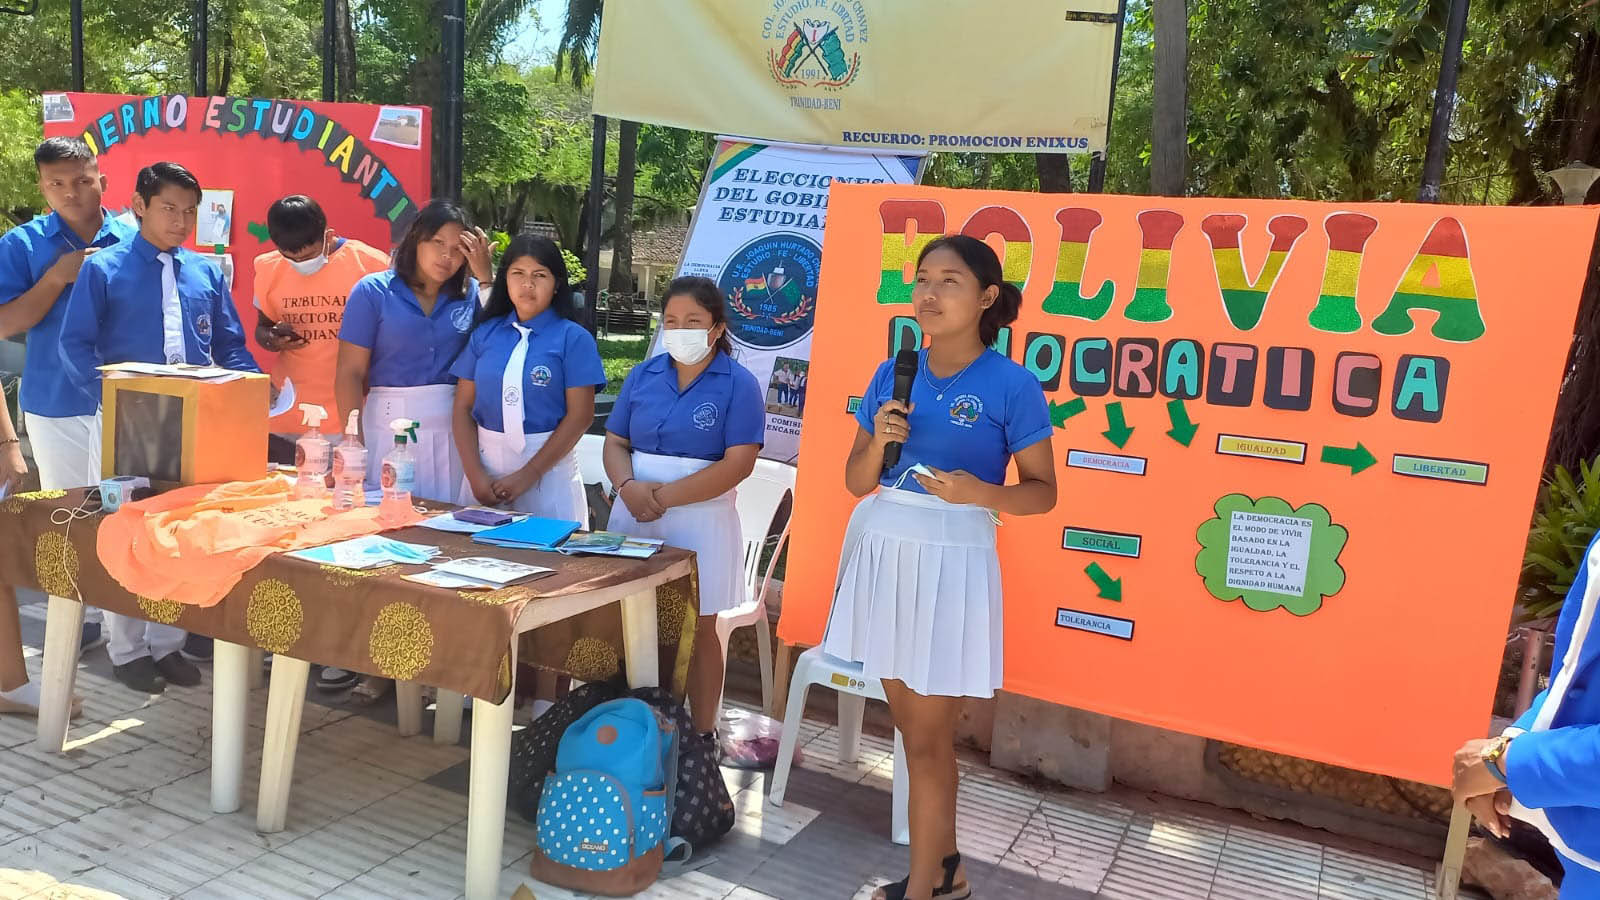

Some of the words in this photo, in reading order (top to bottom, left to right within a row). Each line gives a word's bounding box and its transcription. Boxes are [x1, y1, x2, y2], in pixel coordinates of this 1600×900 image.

[802, 69, 820, 79] 1991
[790, 96, 840, 110] TRINIDAD-BENI
[842, 132, 925, 145] RECUERDO:
[929, 134, 1022, 148] PROMOCION
[1026, 136, 1088, 148] ENIXUS
[712, 187, 758, 202] DEL
[746, 242, 778, 260] JOAQUIN
[741, 252, 770, 279] ESTUDIO
[876, 200, 1486, 342] BOLIVIA
[894, 317, 1439, 412] DOCRATICA
[1237, 442, 1288, 455] IGUALDAD
[1413, 464, 1467, 476] LIBERTAD
[1247, 515, 1299, 525] DEMOCRACIA
[1245, 526, 1267, 534] MODO
[1281, 529, 1302, 538] VIVIR
[1082, 537, 1121, 550] SOCIAL
[1232, 535, 1265, 544] BASADO
[1231, 556, 1280, 568] TOLERANCIA
[1229, 568, 1264, 576] RESPETO
[1228, 578, 1266, 587] DIGNIDAD
[1267, 582, 1302, 592] HUMANA
[1060, 615, 1112, 630] TOLERANCIA
